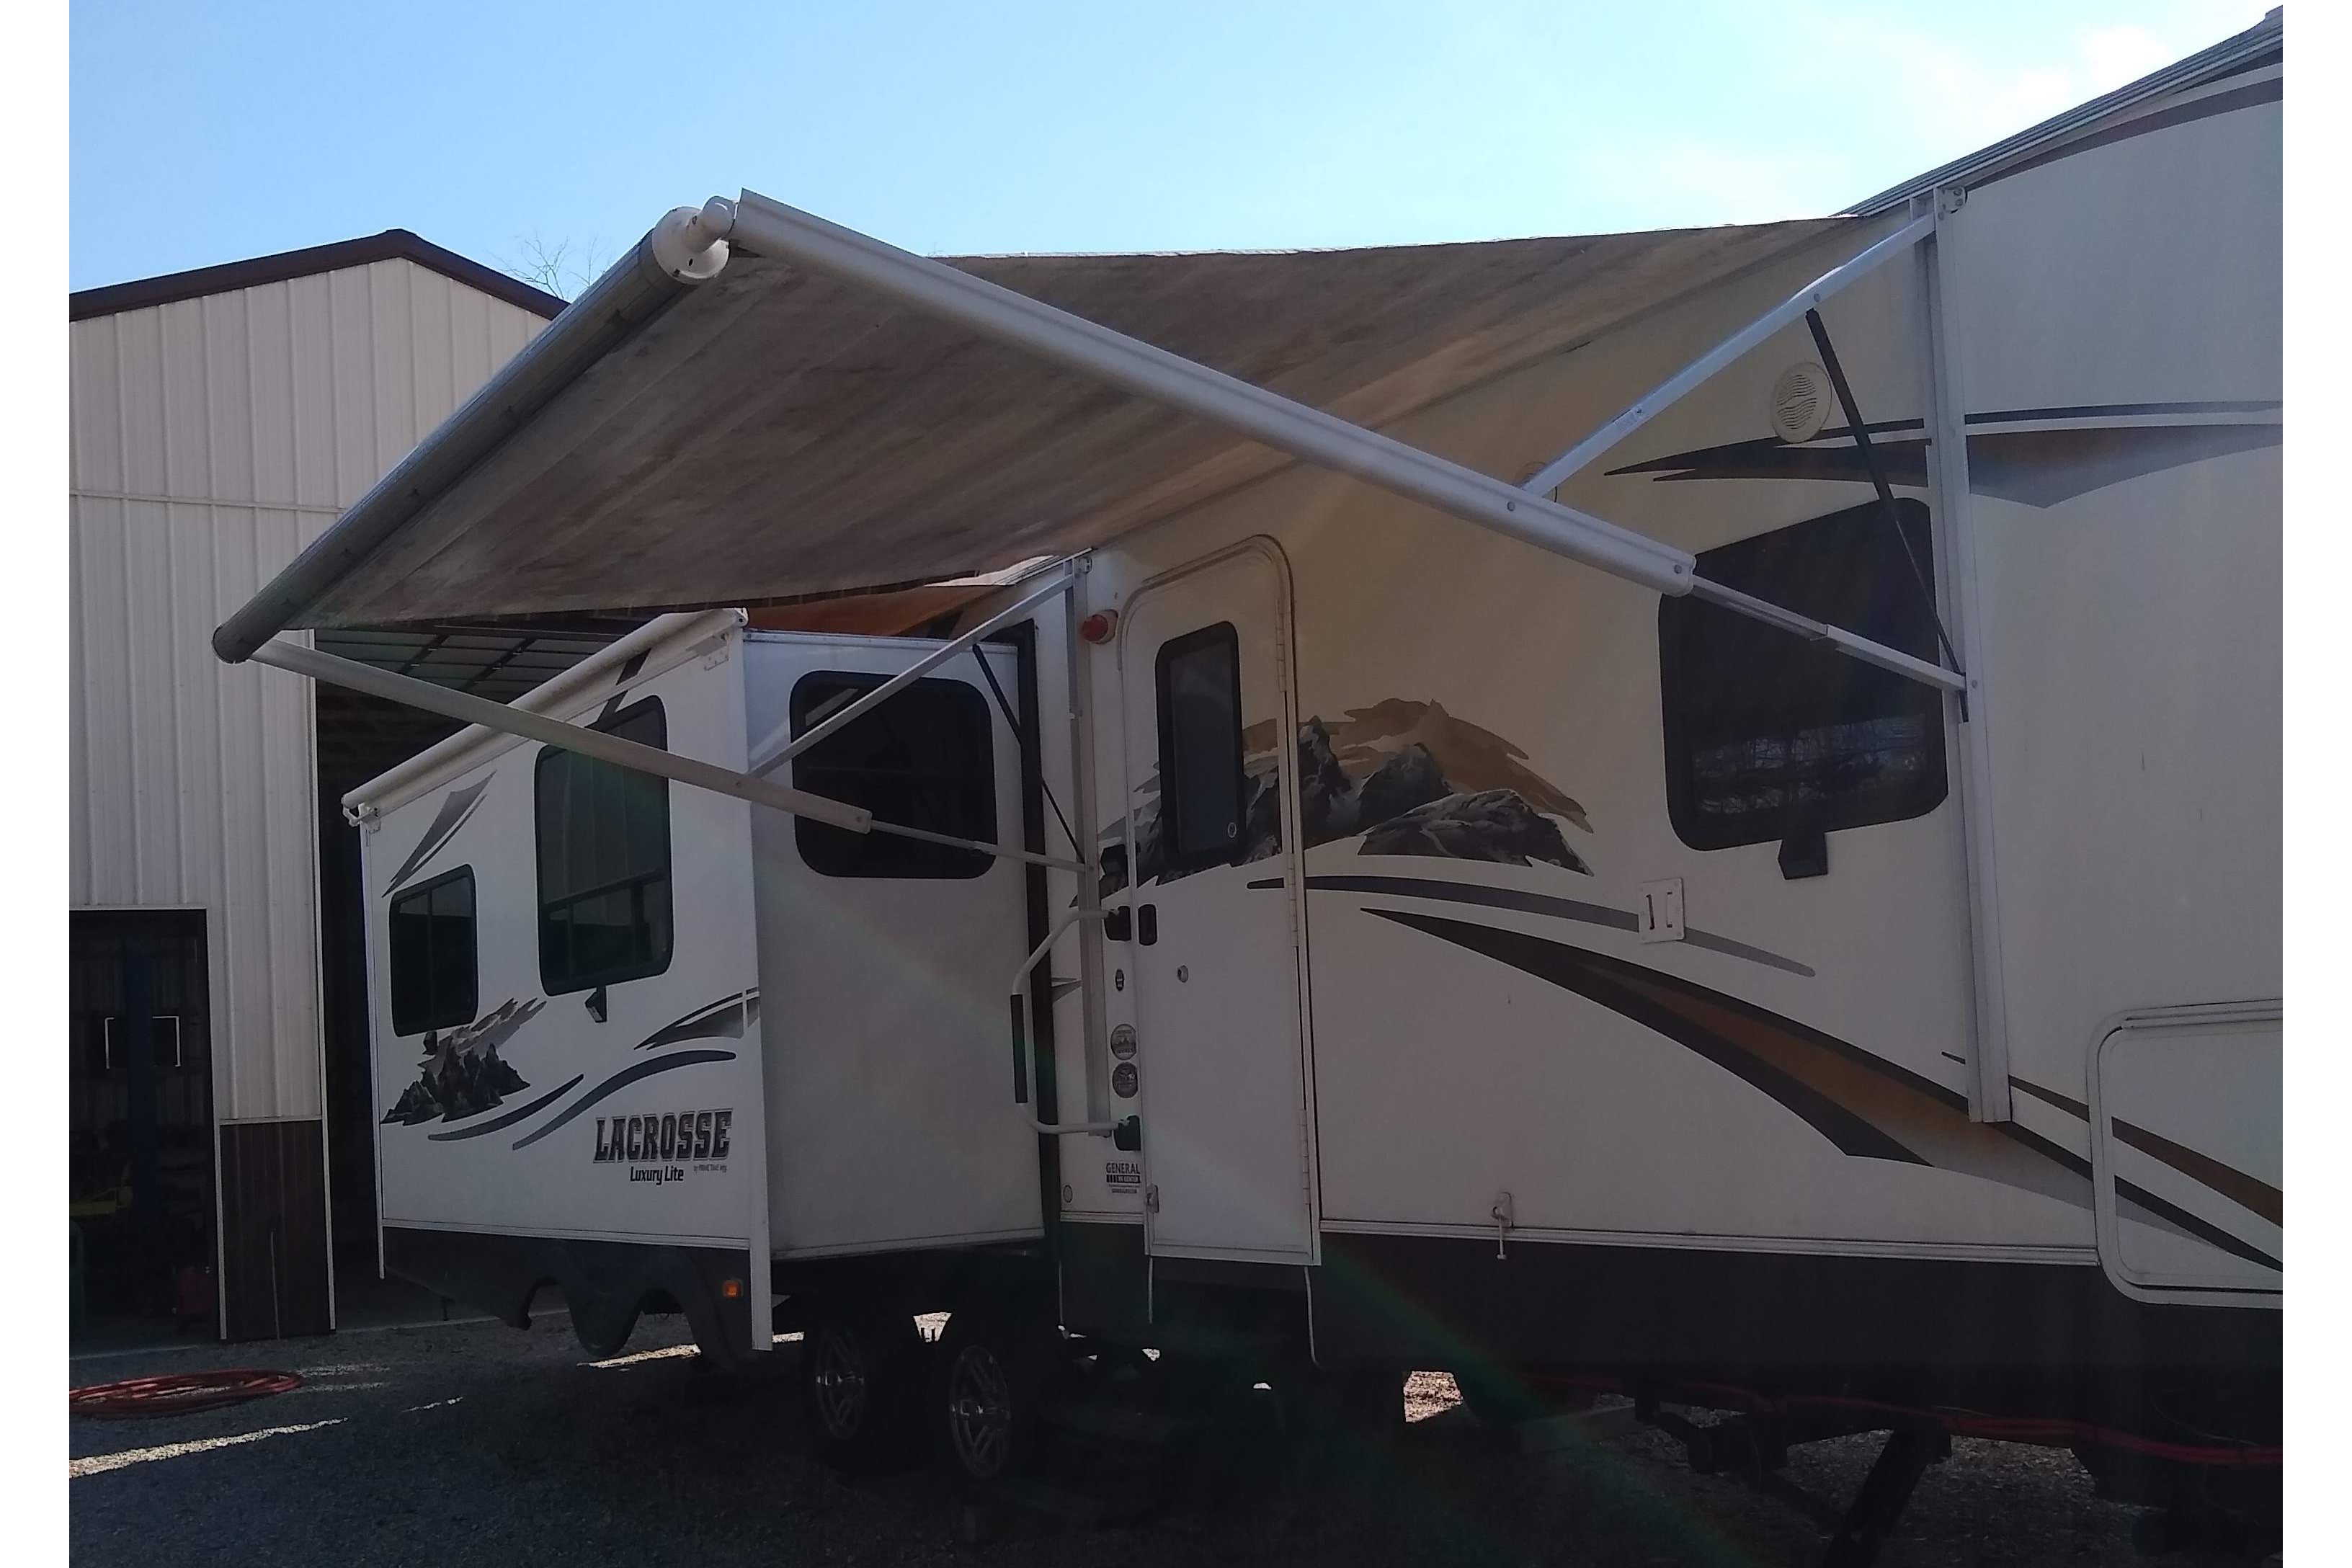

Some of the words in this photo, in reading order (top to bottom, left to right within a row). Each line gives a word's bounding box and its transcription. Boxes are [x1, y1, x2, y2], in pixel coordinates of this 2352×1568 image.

[592, 1108, 734, 1163] LACROSSE
[630, 1166, 663, 1185] Luxury
[664, 1164, 684, 1182] Lite
[1105, 1162, 1141, 1175] GENERAL
